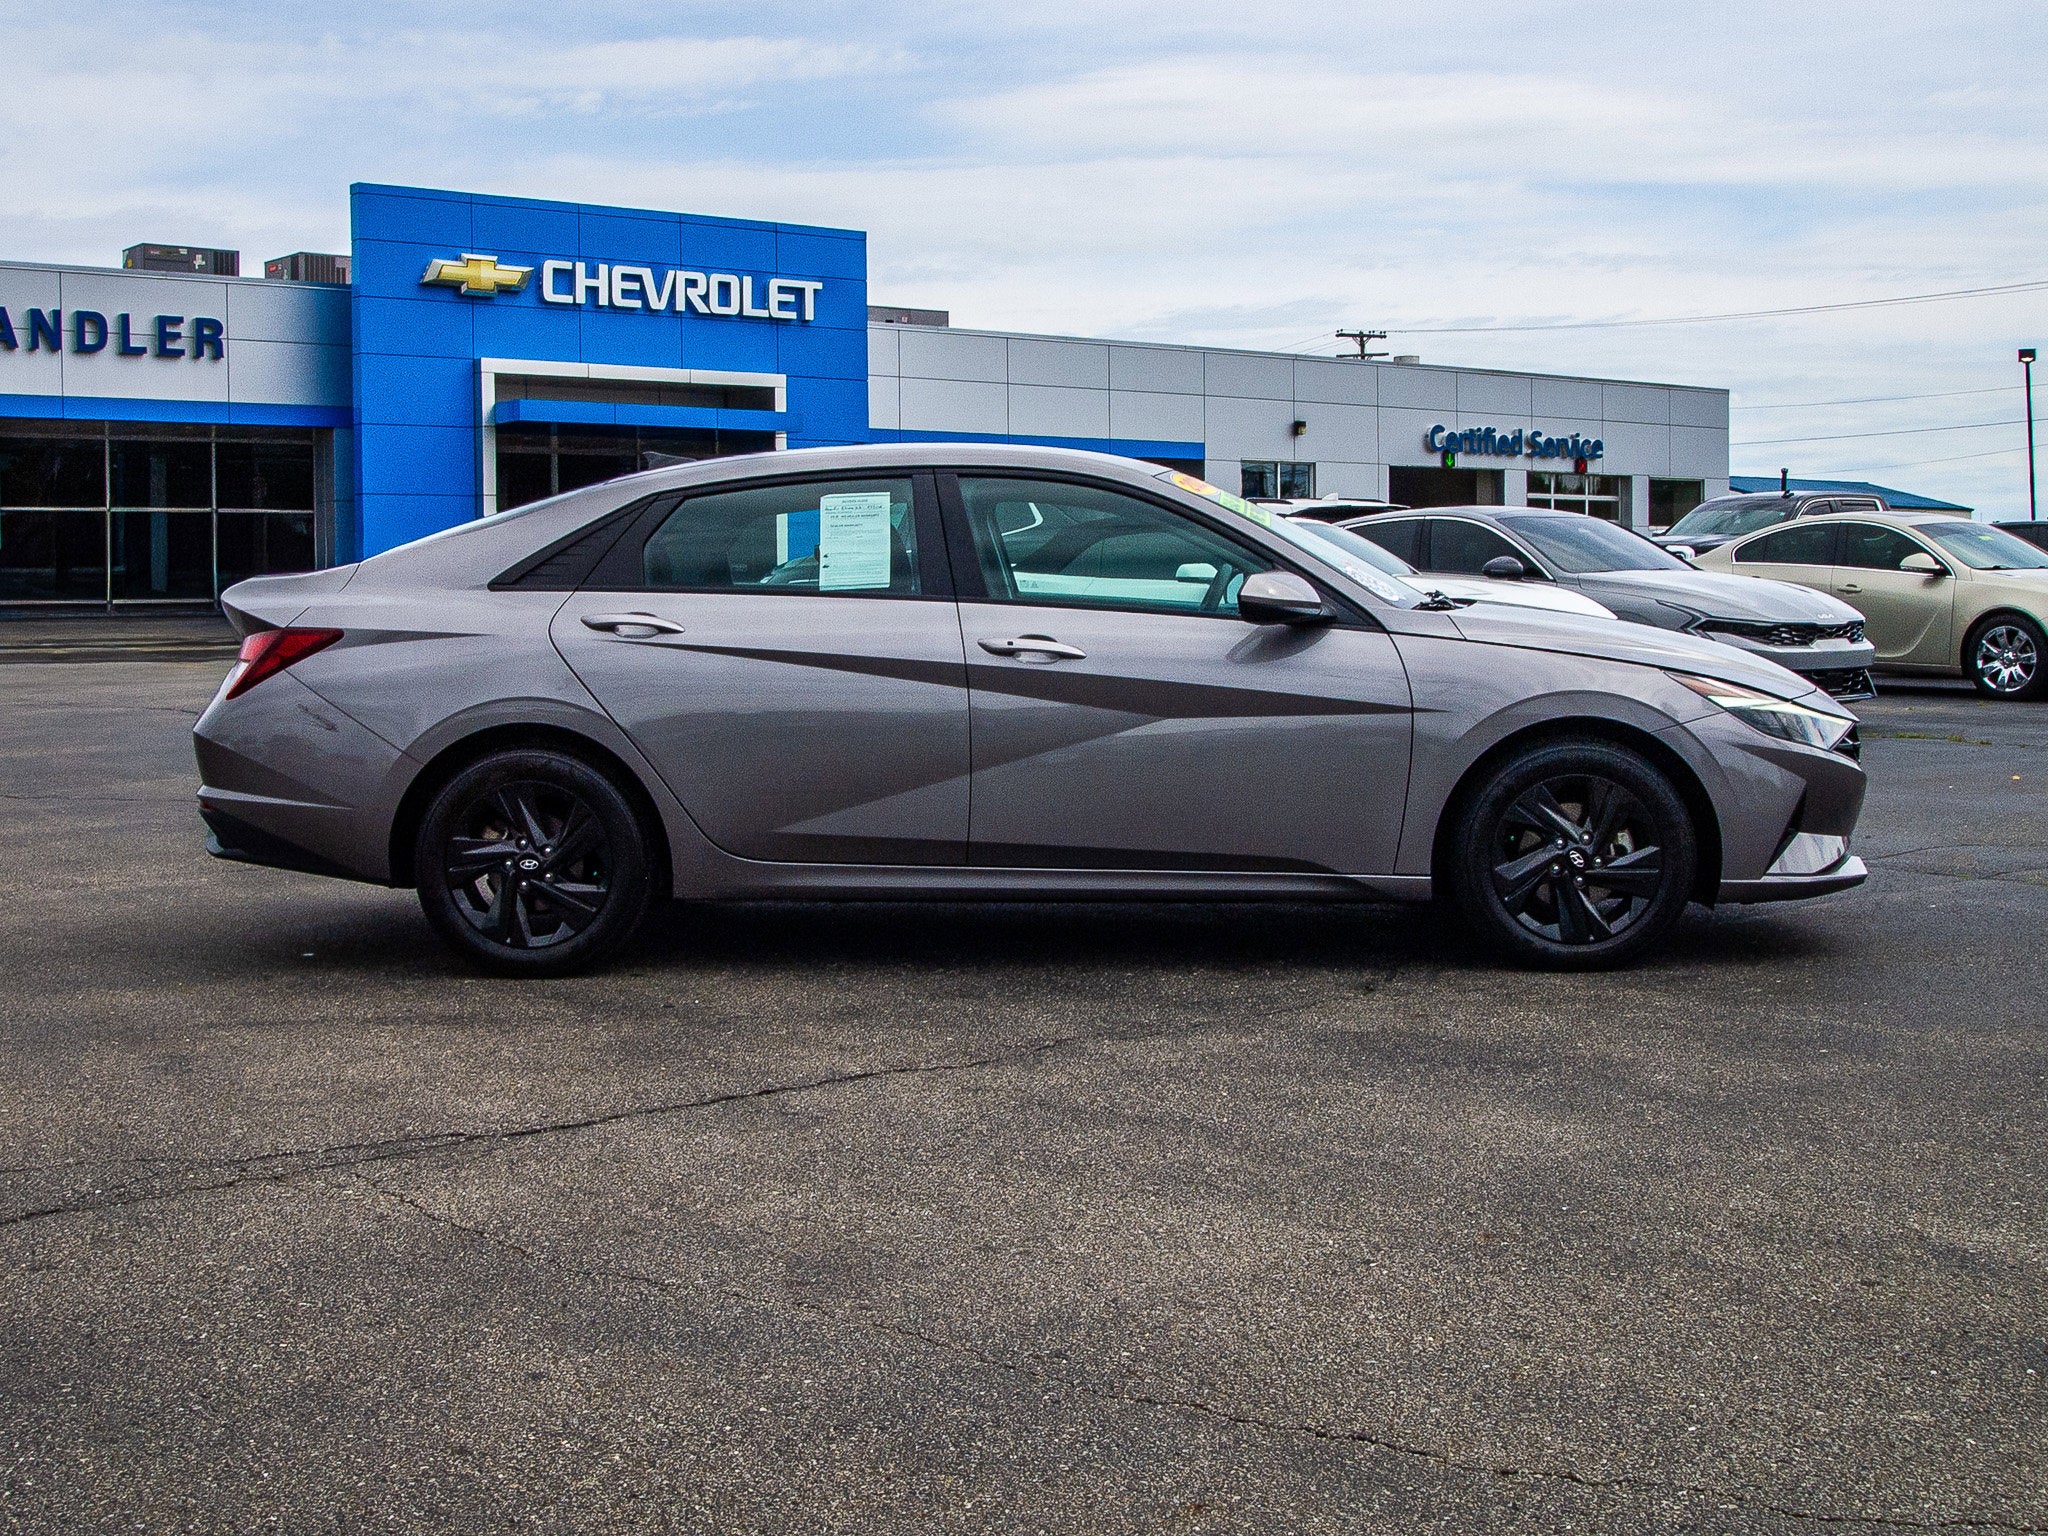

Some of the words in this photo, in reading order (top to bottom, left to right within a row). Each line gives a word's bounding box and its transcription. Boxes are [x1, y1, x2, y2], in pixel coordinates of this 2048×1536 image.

[542, 259, 823, 321] CHEVROLET
[1429, 424, 1523, 455] Certified
[1530, 430, 1604, 460] Service
